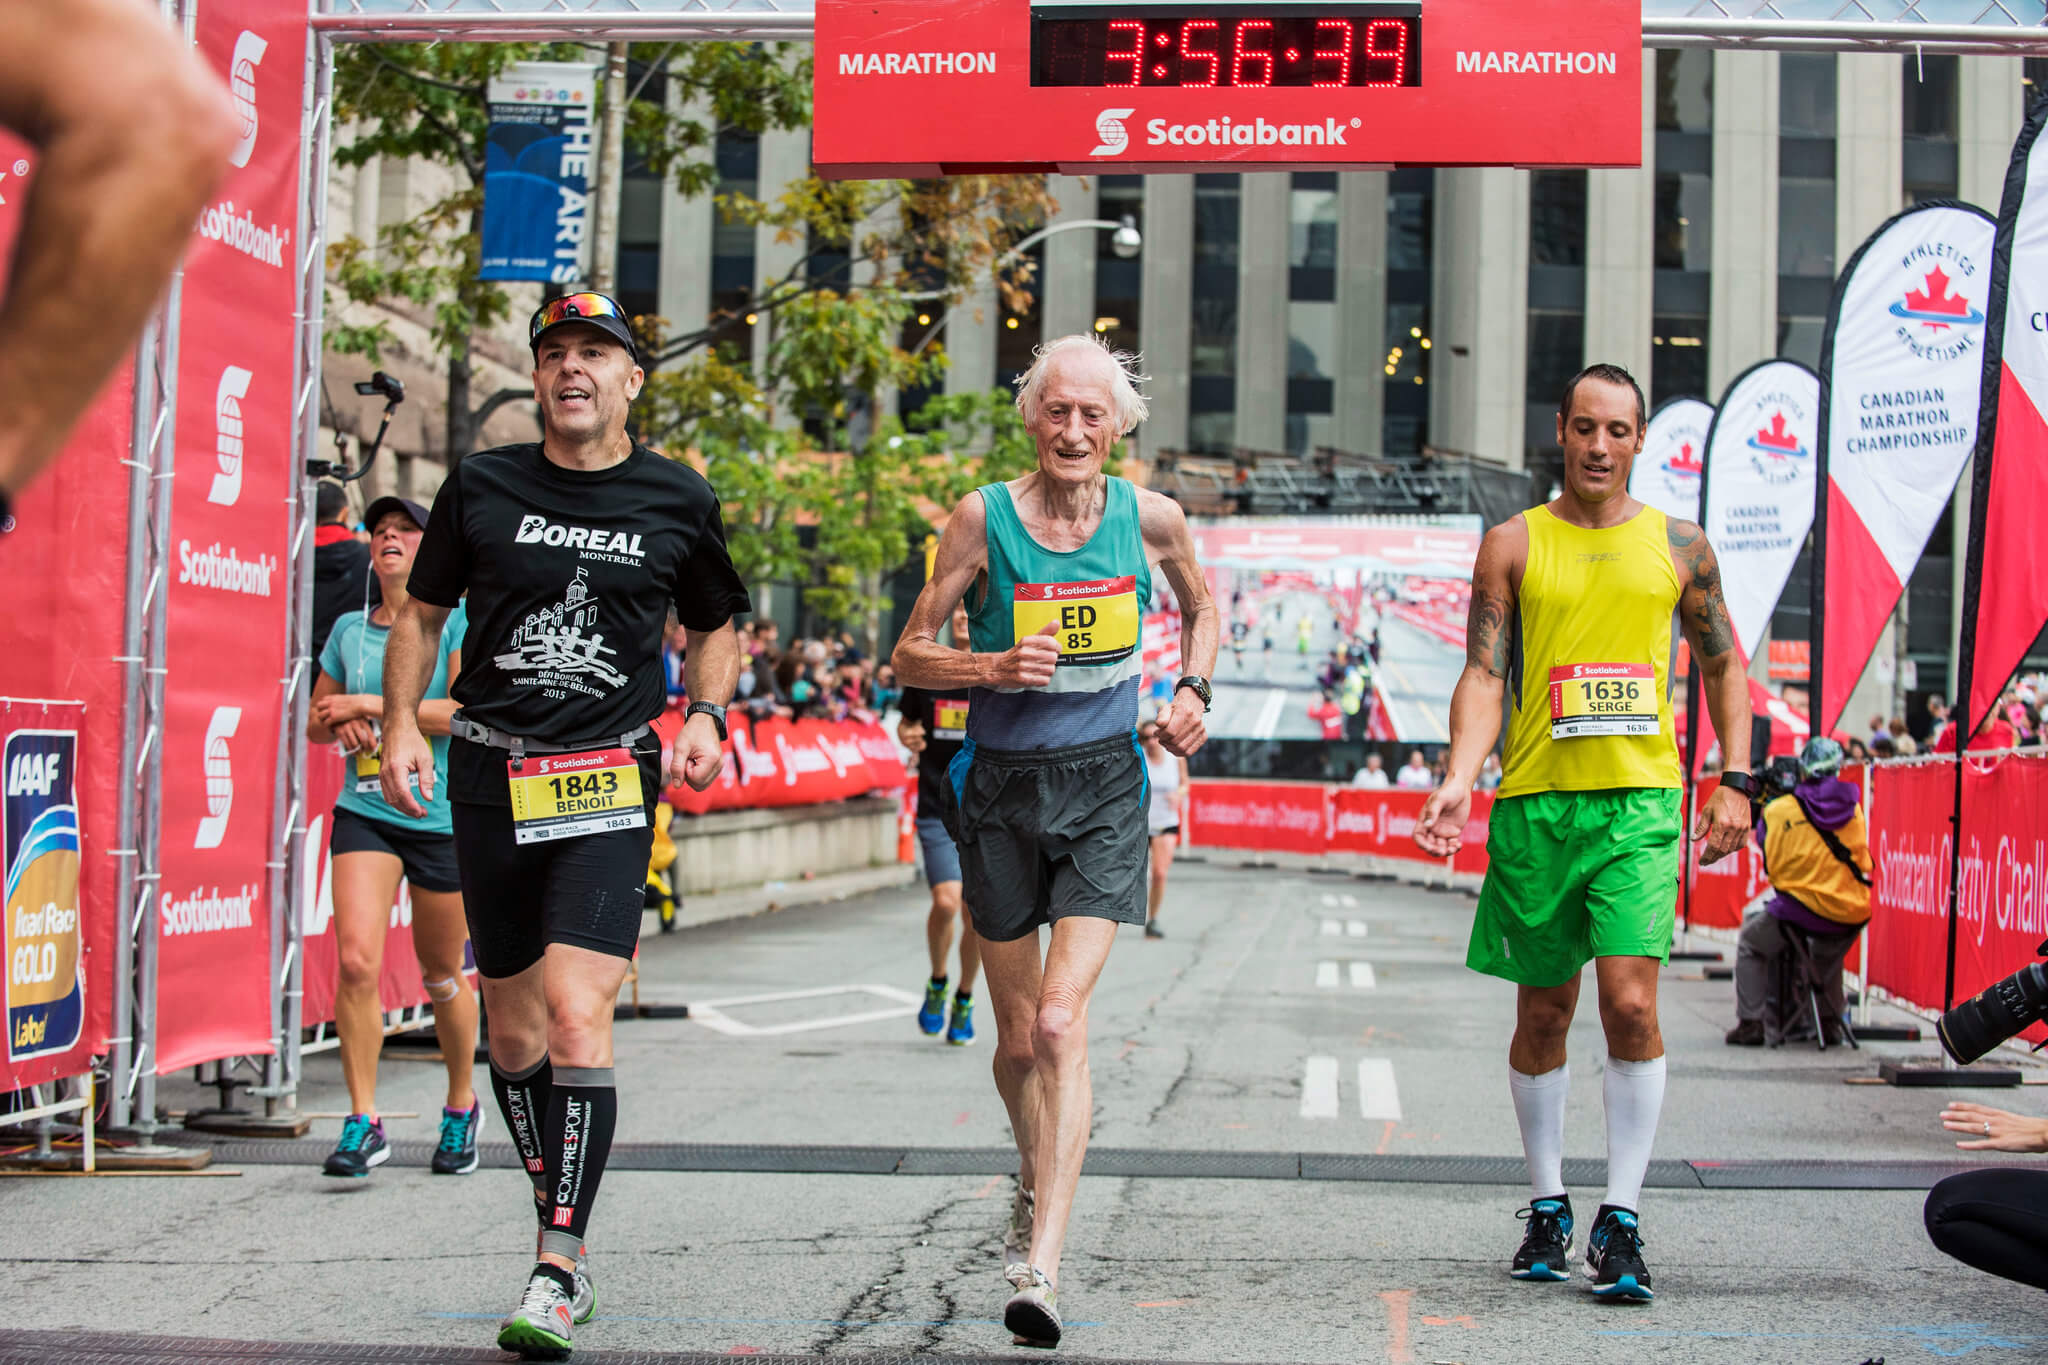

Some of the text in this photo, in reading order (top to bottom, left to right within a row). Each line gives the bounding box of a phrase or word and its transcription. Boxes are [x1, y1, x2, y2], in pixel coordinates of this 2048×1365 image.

[839, 52, 996, 75] MARATHON
[1456, 51, 1616, 74] MARATHON
[1147, 116, 1347, 145] Scotiabank
[551, 106, 593, 283] THE ARTS
[1860, 388, 1944, 409] CANADIAN
[1860, 408, 1950, 430] MARATHON
[1847, 428, 1967, 453] CHAMPIONSHIP
[514, 515, 646, 557] BOREAL
[179, 540, 271, 597] Scotiabank
[579, 551, 641, 567] MONTREAL
[1057, 584, 1109, 596] Scotiabank
[1061, 605, 1097, 630] ED
[1067, 632, 1092, 649] 85
[1585, 666, 1629, 674] Scotiabank
[542, 688, 567, 700] 2015
[1581, 681, 1640, 700] 1636
[1589, 701, 1633, 712] SERGE
[1626, 724, 1648, 732] 1636
[8, 753, 60, 796] IAAF
[553, 757, 604, 769] Scotiabank
[549, 772, 618, 799] 1843
[556, 795, 615, 813] BENOIT
[605, 818, 632, 829] 1843
[1878, 829, 1936, 916] Scotiabank
[161, 884, 252, 936] Scotiabank
[13, 942, 57, 985] GOLD
[15, 1012, 48, 1048] Label
[556, 1099, 582, 1204] COMPRESSPORT
